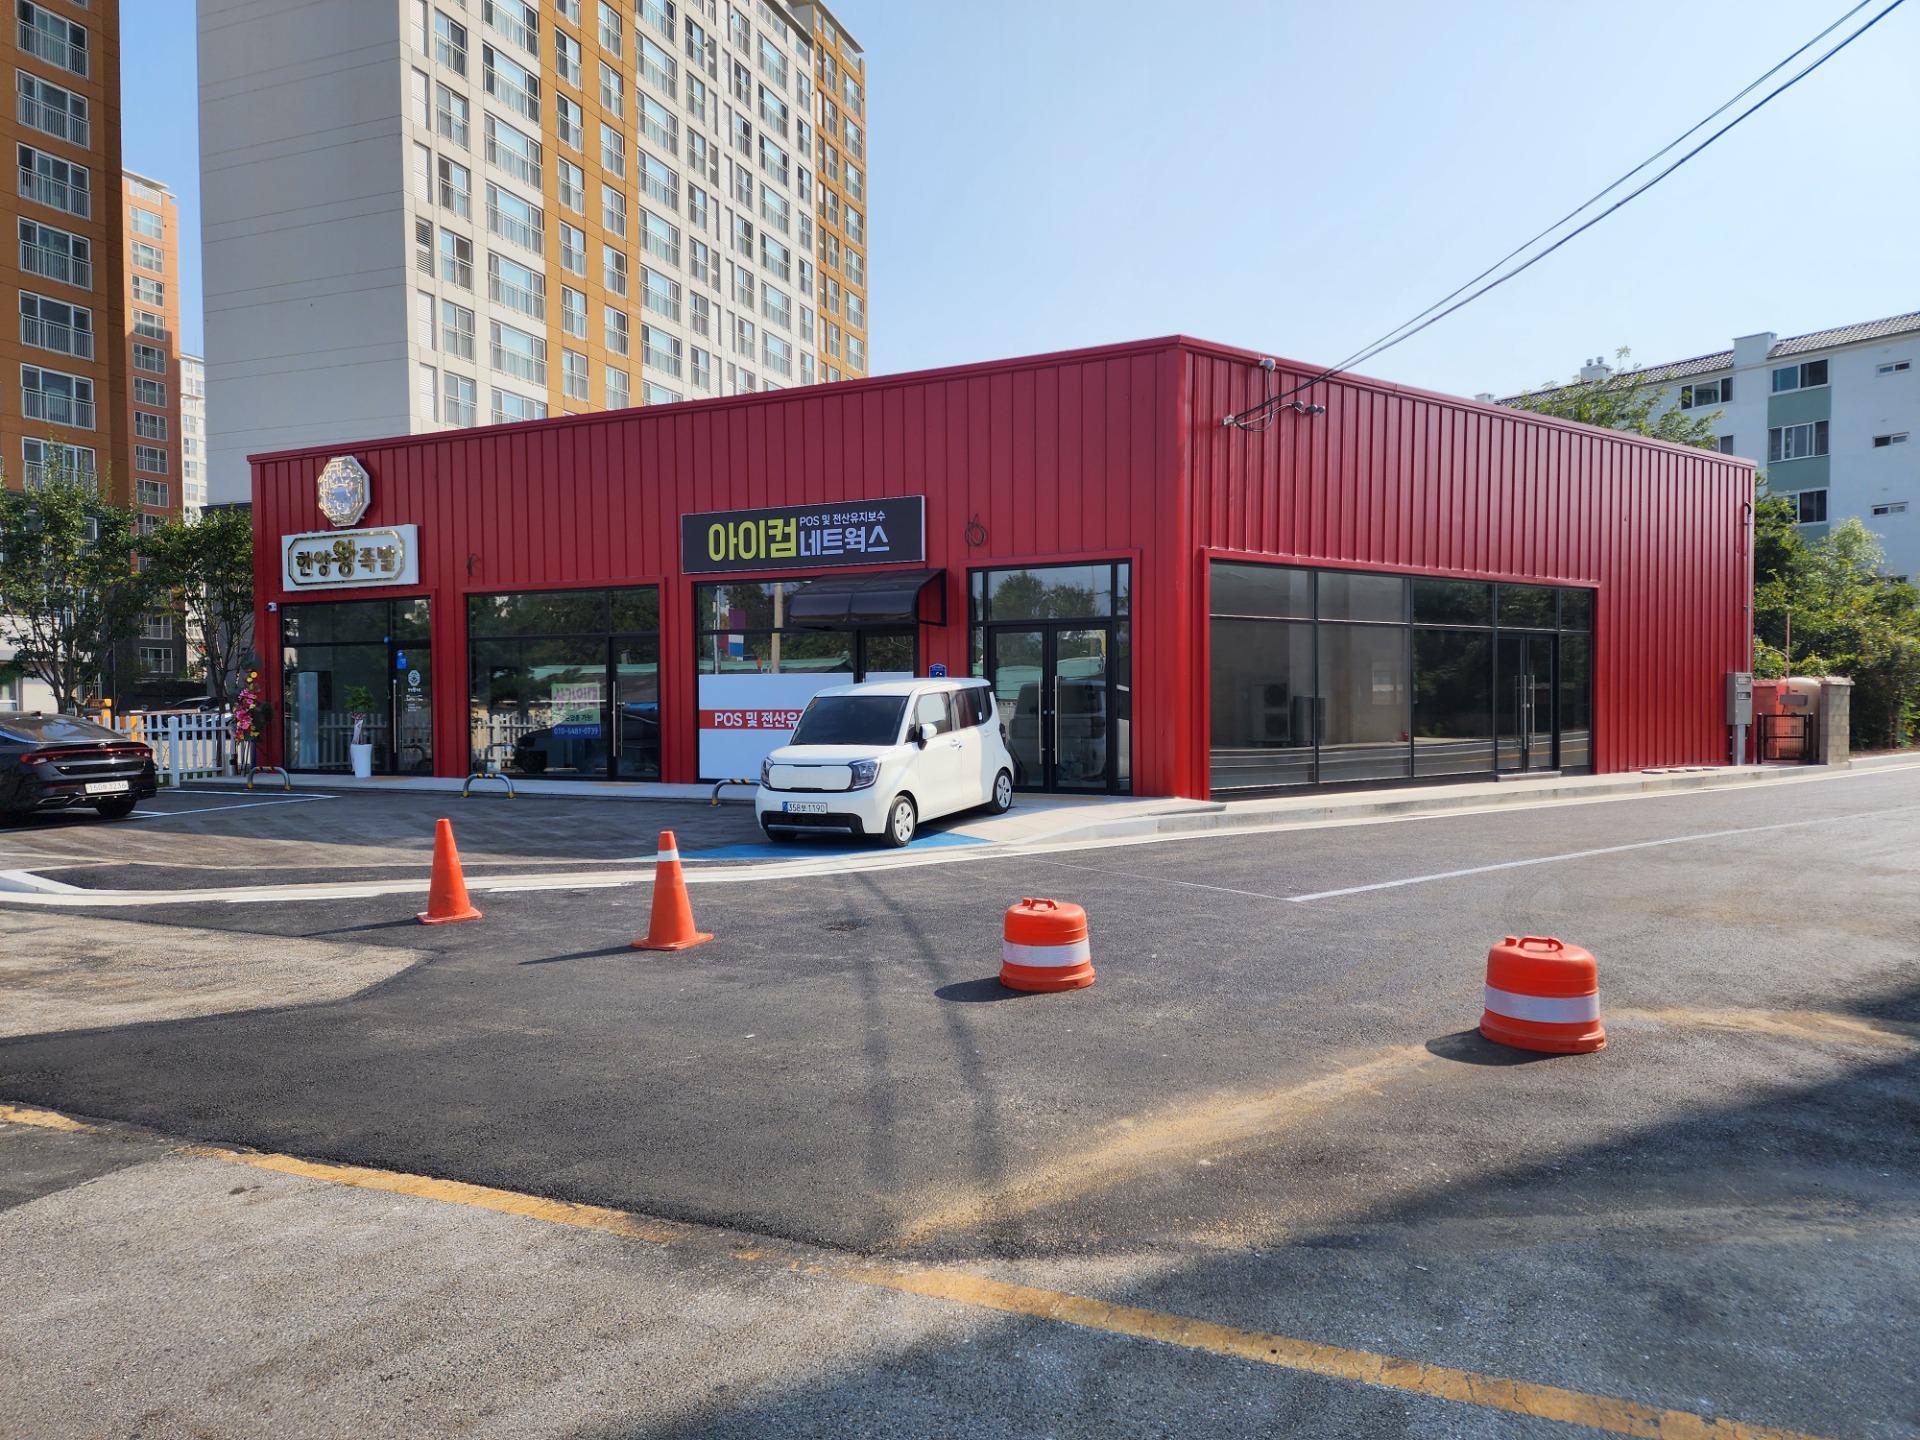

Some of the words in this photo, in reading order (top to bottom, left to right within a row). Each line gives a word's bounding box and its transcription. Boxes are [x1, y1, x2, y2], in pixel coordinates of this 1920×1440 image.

[800, 516, 820, 527] POS
[821, 514, 831, 526] 및
[833, 510, 885, 525] 전산유지보수
[708, 518, 796, 561] 아이컴
[800, 526, 889, 556] 네트웍스
[296, 540, 396, 577] 한양왕족발
[714, 712, 743, 727] POS
[746, 711, 758, 728] 및
[761, 711, 803, 728] 전산유
